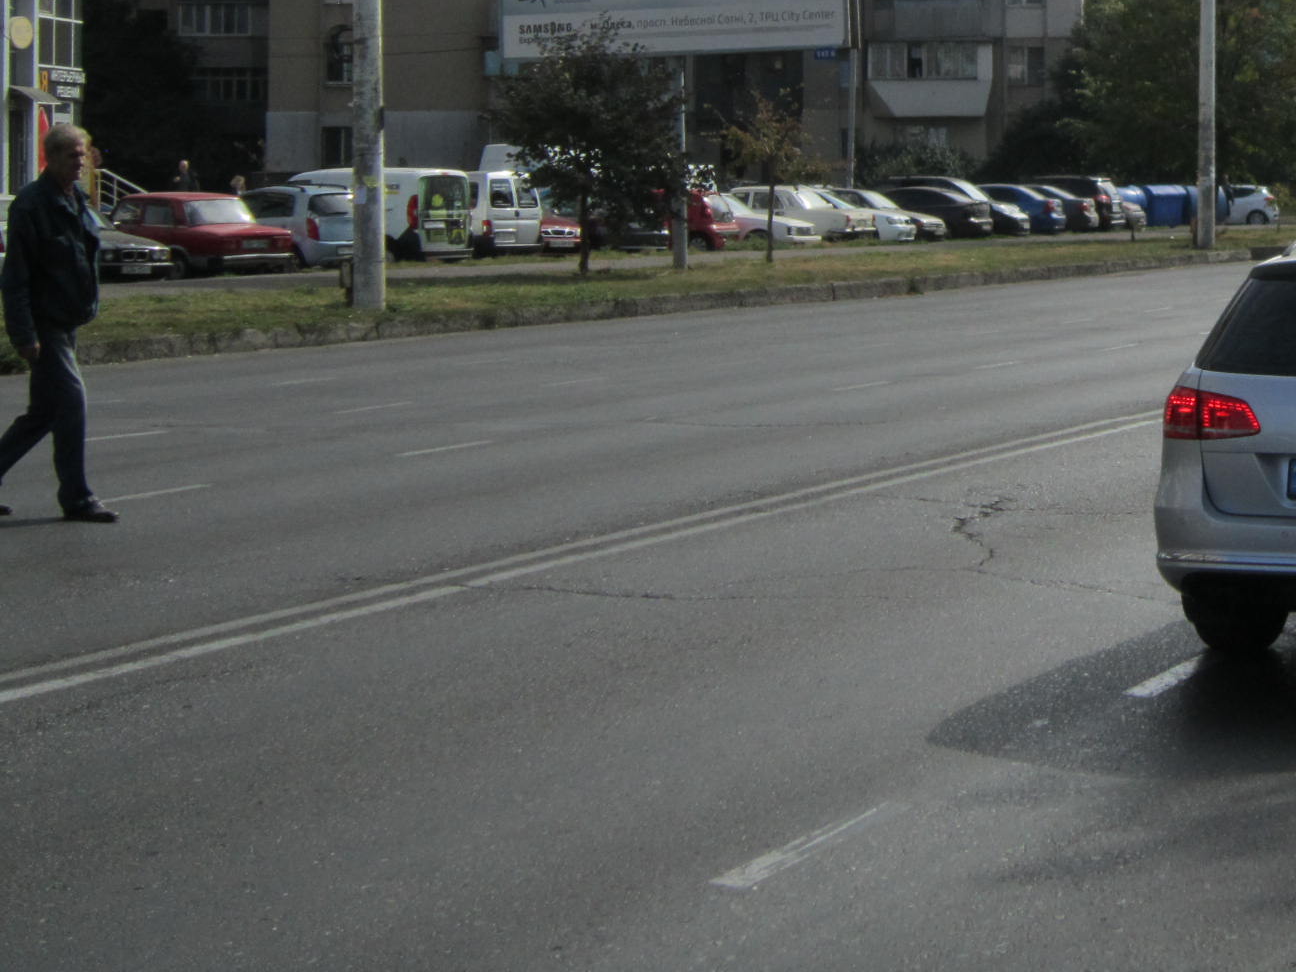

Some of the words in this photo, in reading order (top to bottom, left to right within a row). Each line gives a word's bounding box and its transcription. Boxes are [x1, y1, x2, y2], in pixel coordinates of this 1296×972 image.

[672, 14, 715, 26] Небесної
[781, 11, 800, 22] City
[802, 10, 834, 20] Center
